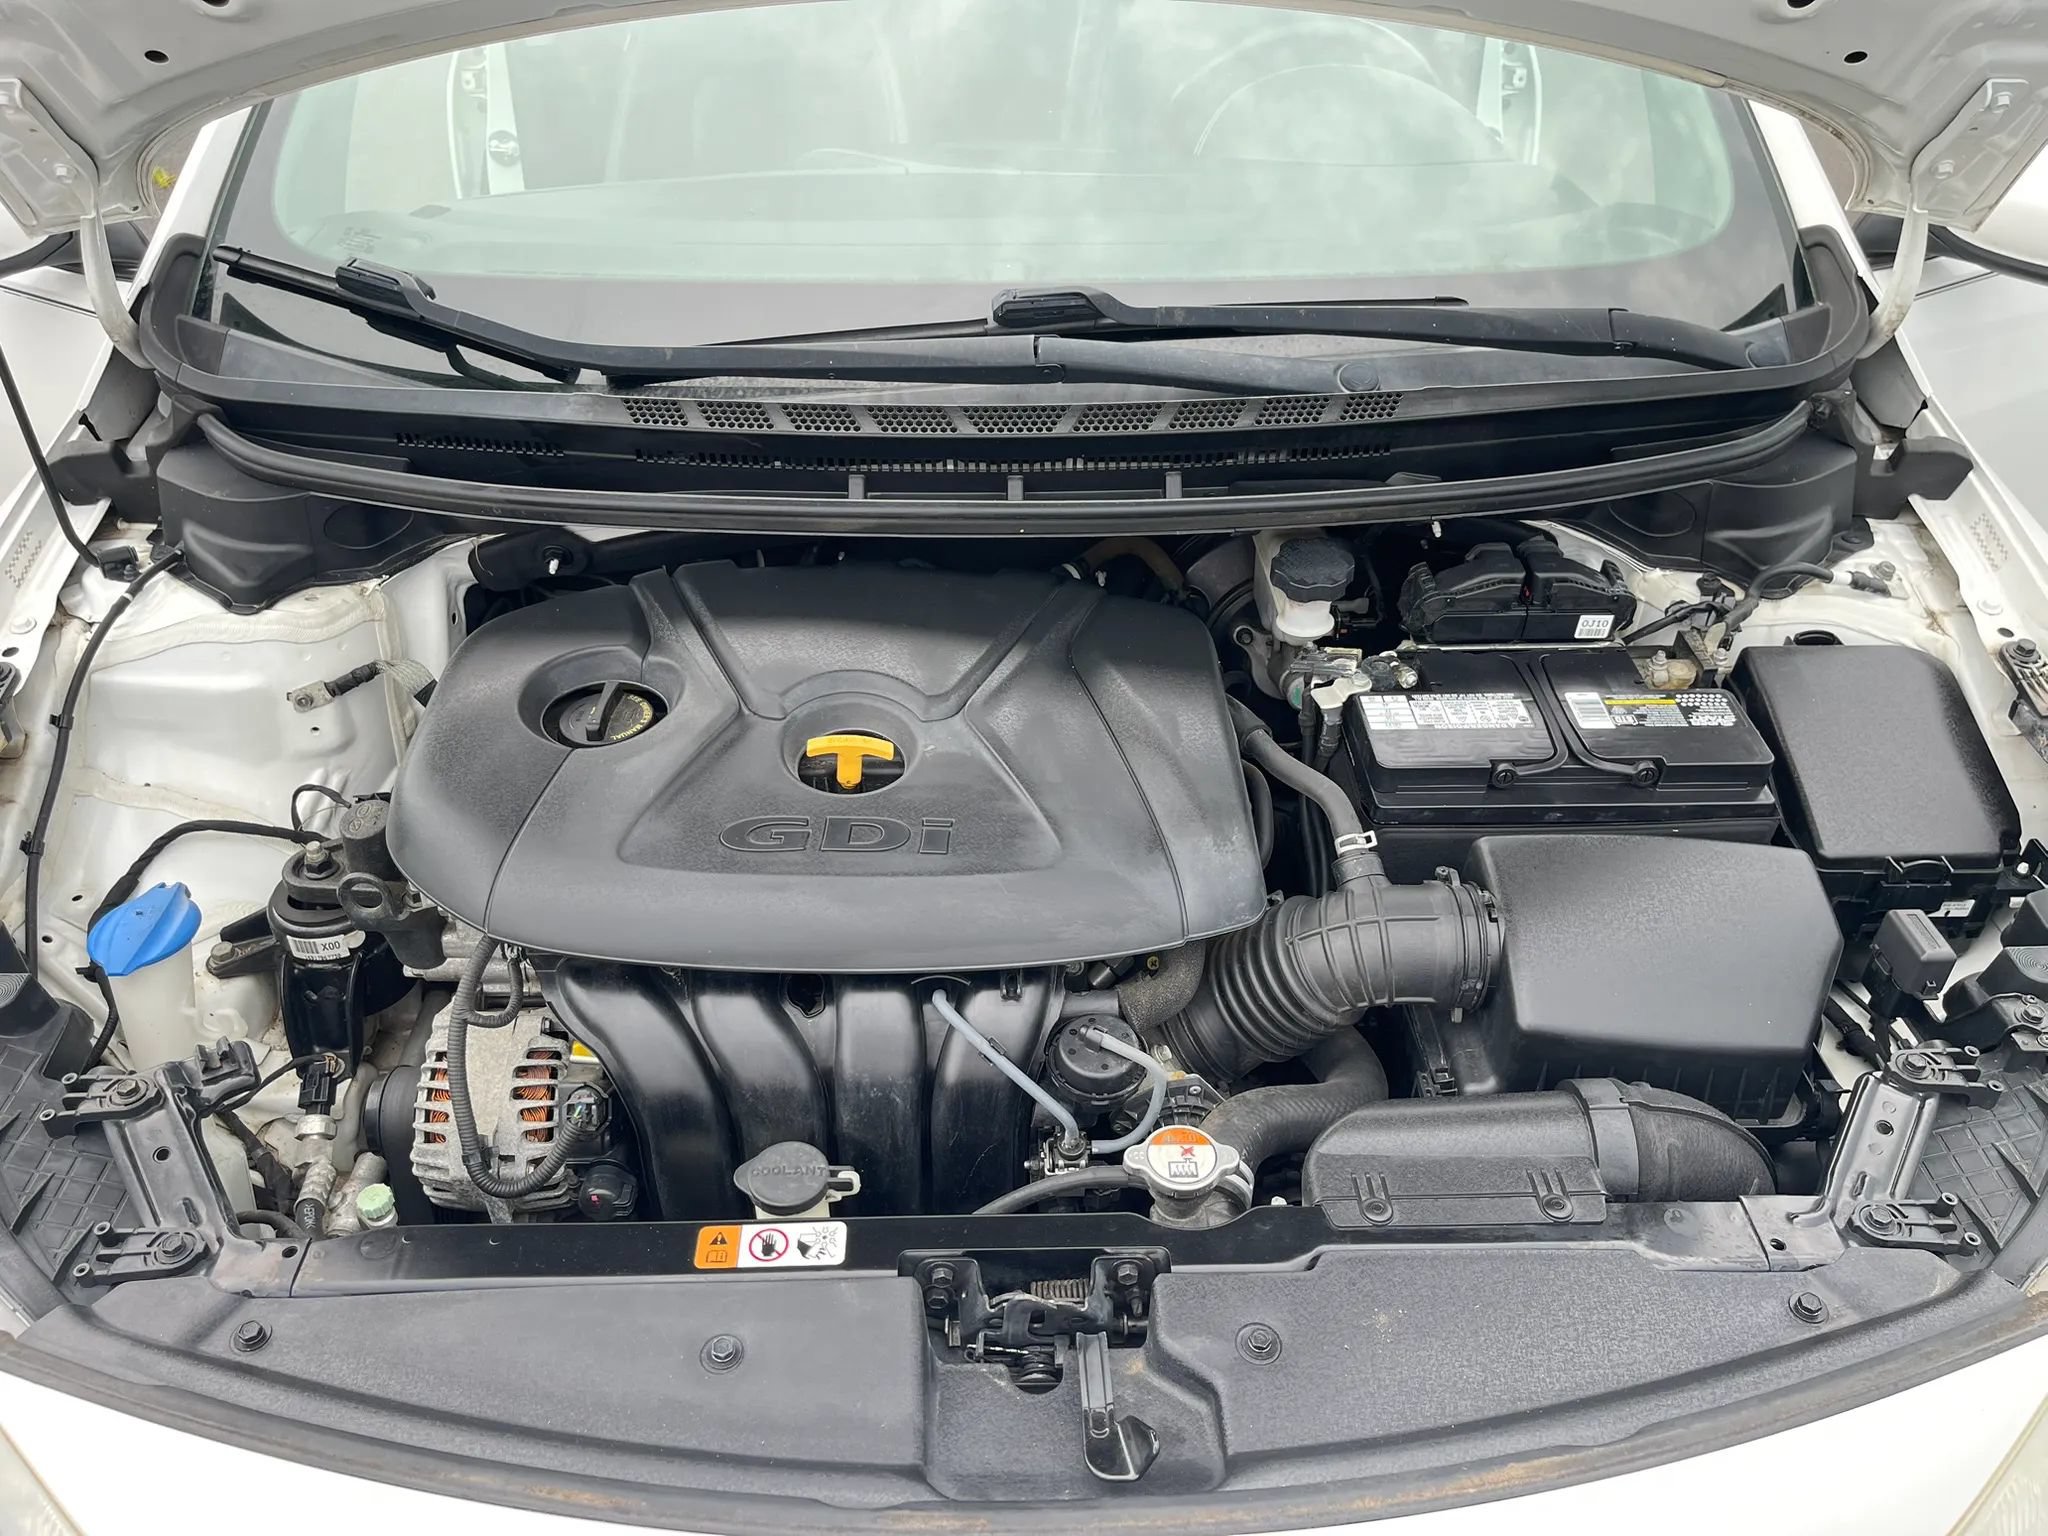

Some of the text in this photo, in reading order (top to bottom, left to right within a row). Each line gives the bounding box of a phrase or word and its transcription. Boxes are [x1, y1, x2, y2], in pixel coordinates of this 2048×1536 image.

[718, 815, 956, 855] GDi
[320, 940, 341, 952] X00
[751, 1165, 827, 1177] COOLANT
